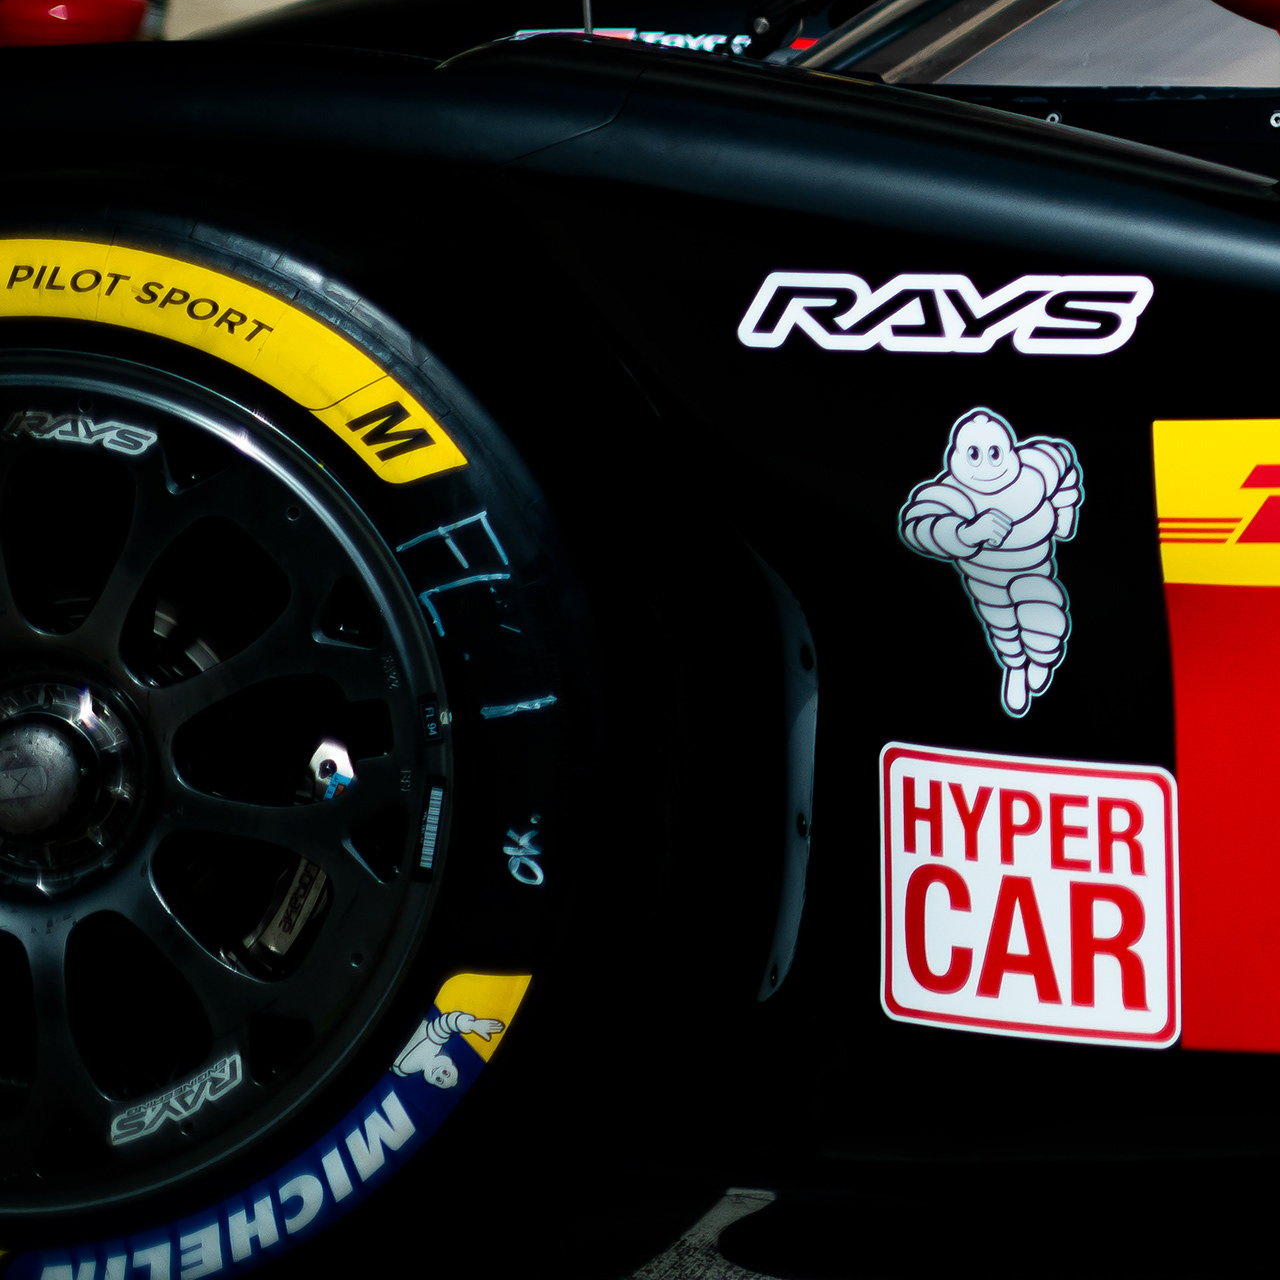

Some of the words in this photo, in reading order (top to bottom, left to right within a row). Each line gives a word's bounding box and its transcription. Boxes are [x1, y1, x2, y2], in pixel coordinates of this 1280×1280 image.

[5, 264, 131, 298] PILOT
[134, 280, 274, 343] SPORT
[737, 271, 1155, 355] RAYS
[2, 411, 158, 456] RAYS
[346, 401, 436, 462] M
[901, 776, 1148, 877] HYPER
[902, 862, 1150, 1013] CAR
[111, 1054, 242, 1146] RAYS
